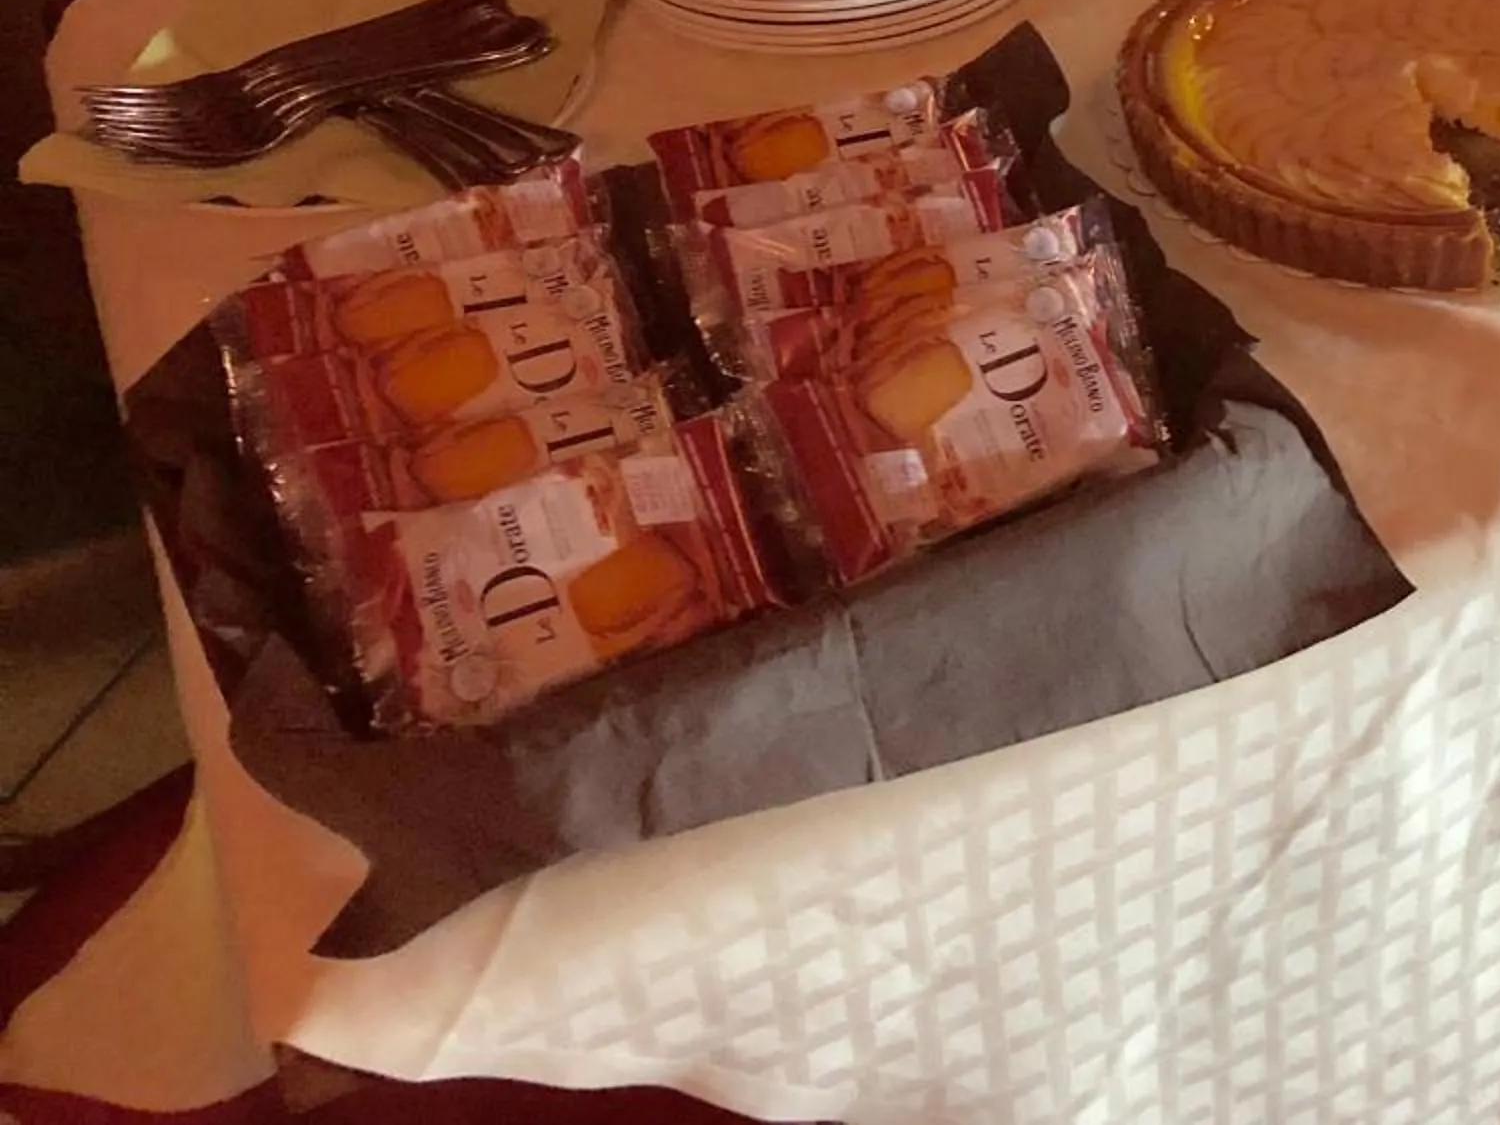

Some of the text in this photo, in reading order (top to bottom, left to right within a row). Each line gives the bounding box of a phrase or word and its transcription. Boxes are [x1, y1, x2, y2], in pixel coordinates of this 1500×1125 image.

[978, 341, 1048, 462] Dorate
[979, 330, 998, 355] Le
[479, 502, 564, 627] Dorate
